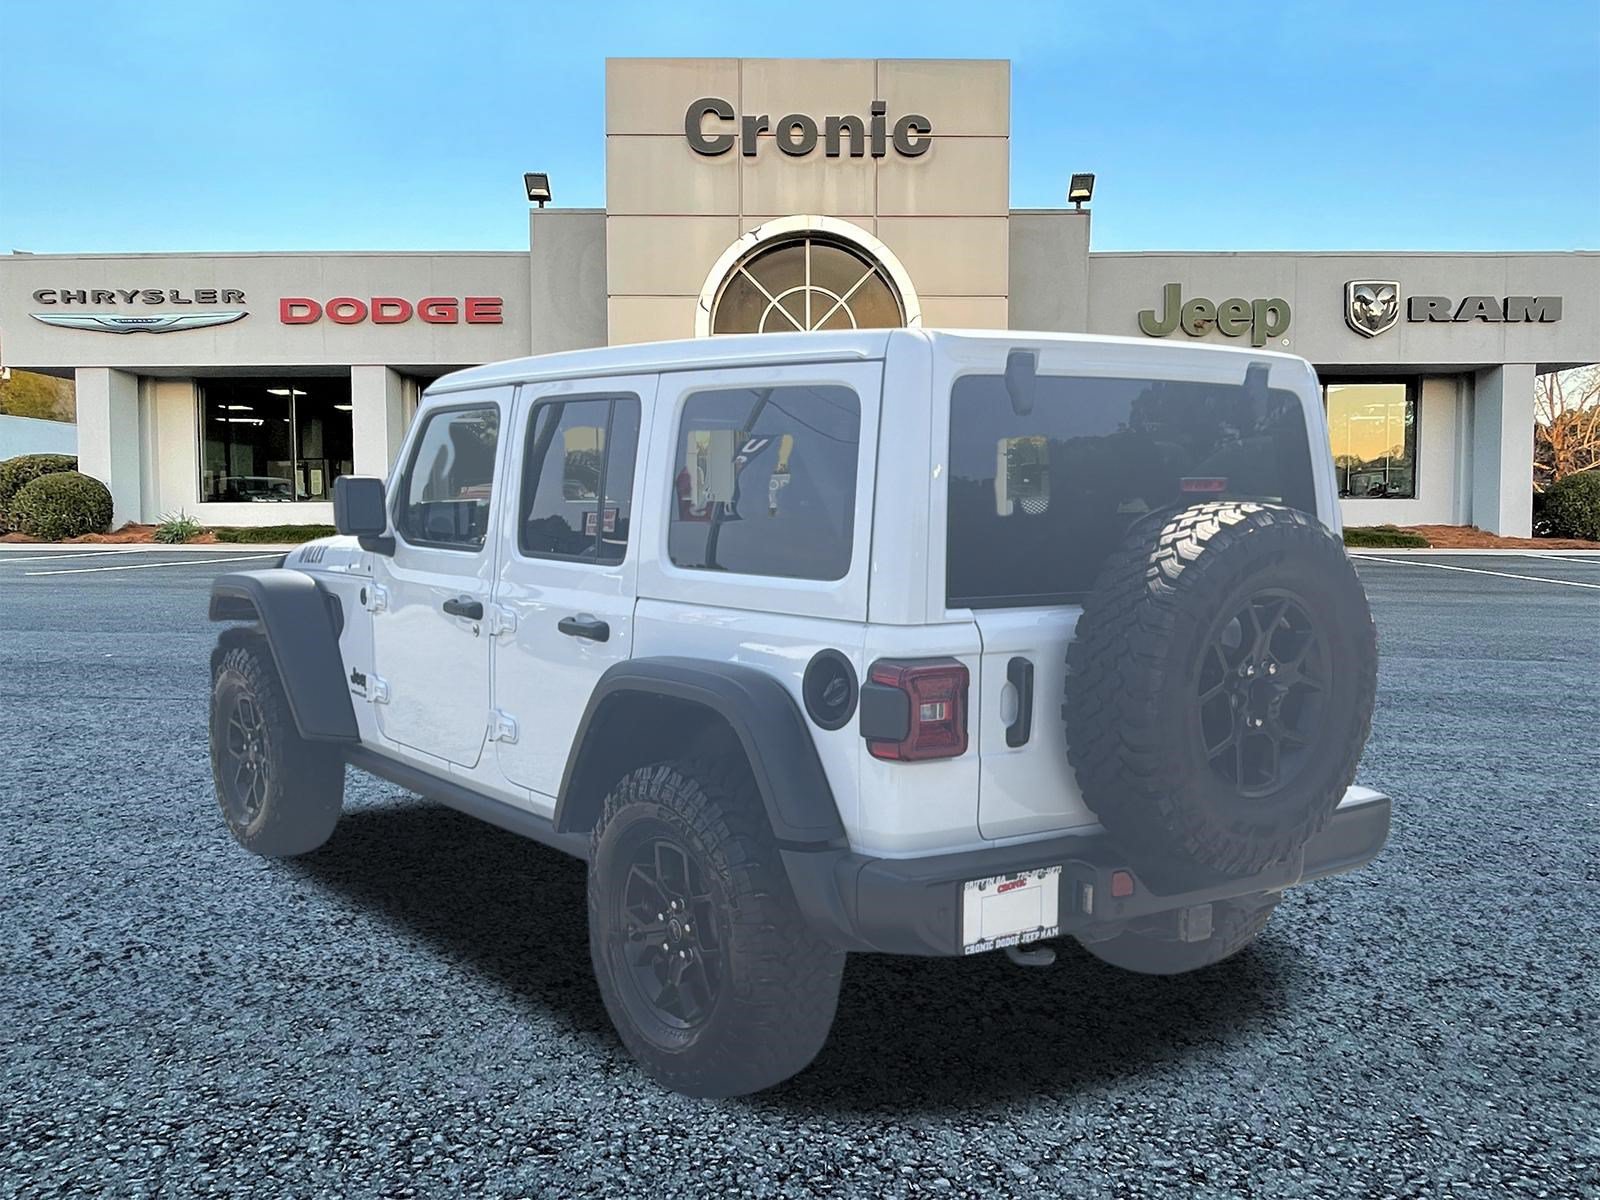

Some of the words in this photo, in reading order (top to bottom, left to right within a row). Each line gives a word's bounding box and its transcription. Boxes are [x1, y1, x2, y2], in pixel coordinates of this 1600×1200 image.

[685, 97, 932, 157] Cronic
[32, 288, 248, 306] CHRYSLER
[279, 296, 504, 324] DODGE
[1407, 295, 1563, 323] RAM
[1138, 283, 1291, 346] Jeep
[964, 941, 994, 956] CRONIC
